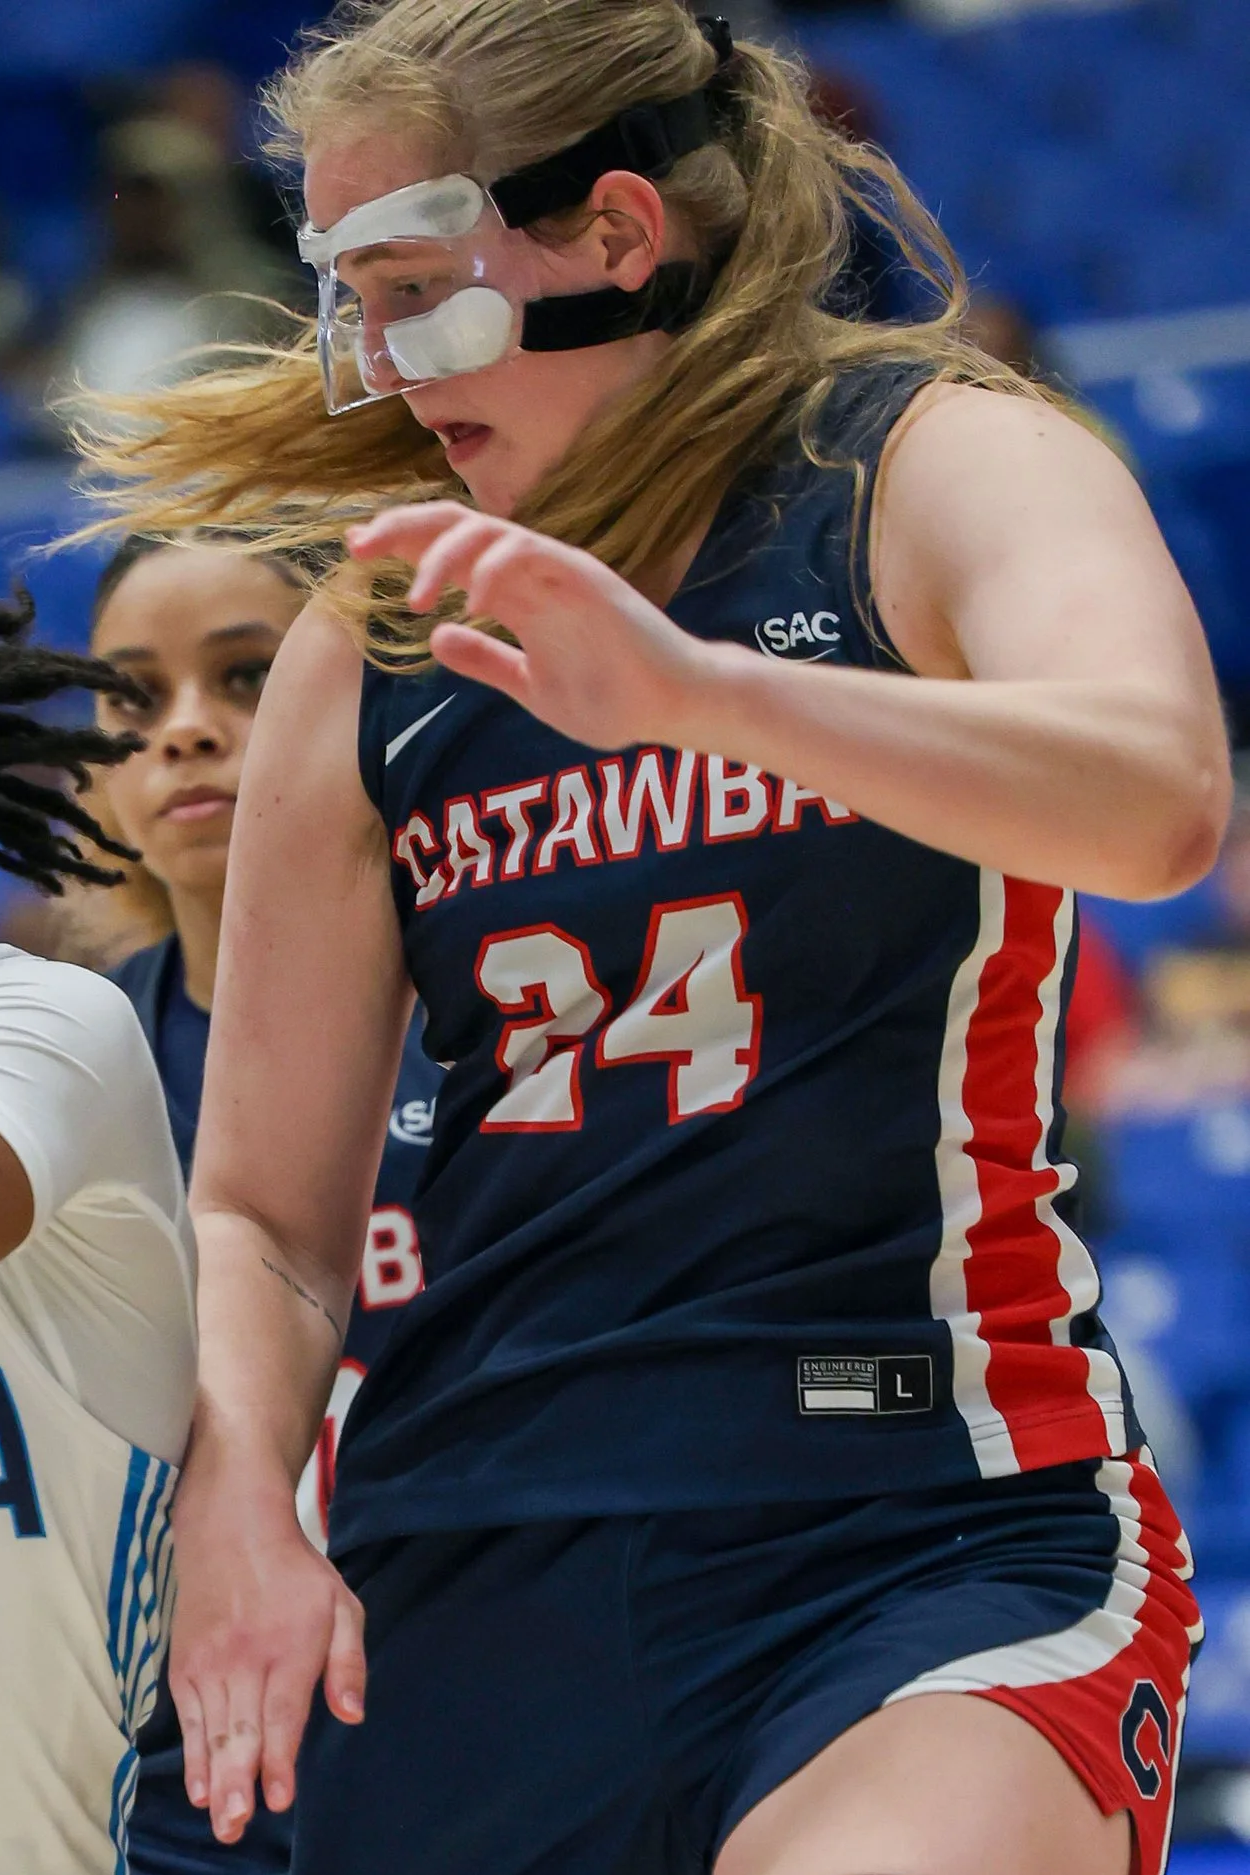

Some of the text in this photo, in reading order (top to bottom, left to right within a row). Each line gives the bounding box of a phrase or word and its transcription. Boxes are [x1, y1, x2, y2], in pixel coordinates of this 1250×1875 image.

[763, 611, 841, 651] SAC
[474, 891, 763, 1134] 24
[803, 1361, 875, 1372] ENGINEERED
[896, 1373, 913, 1398] L
